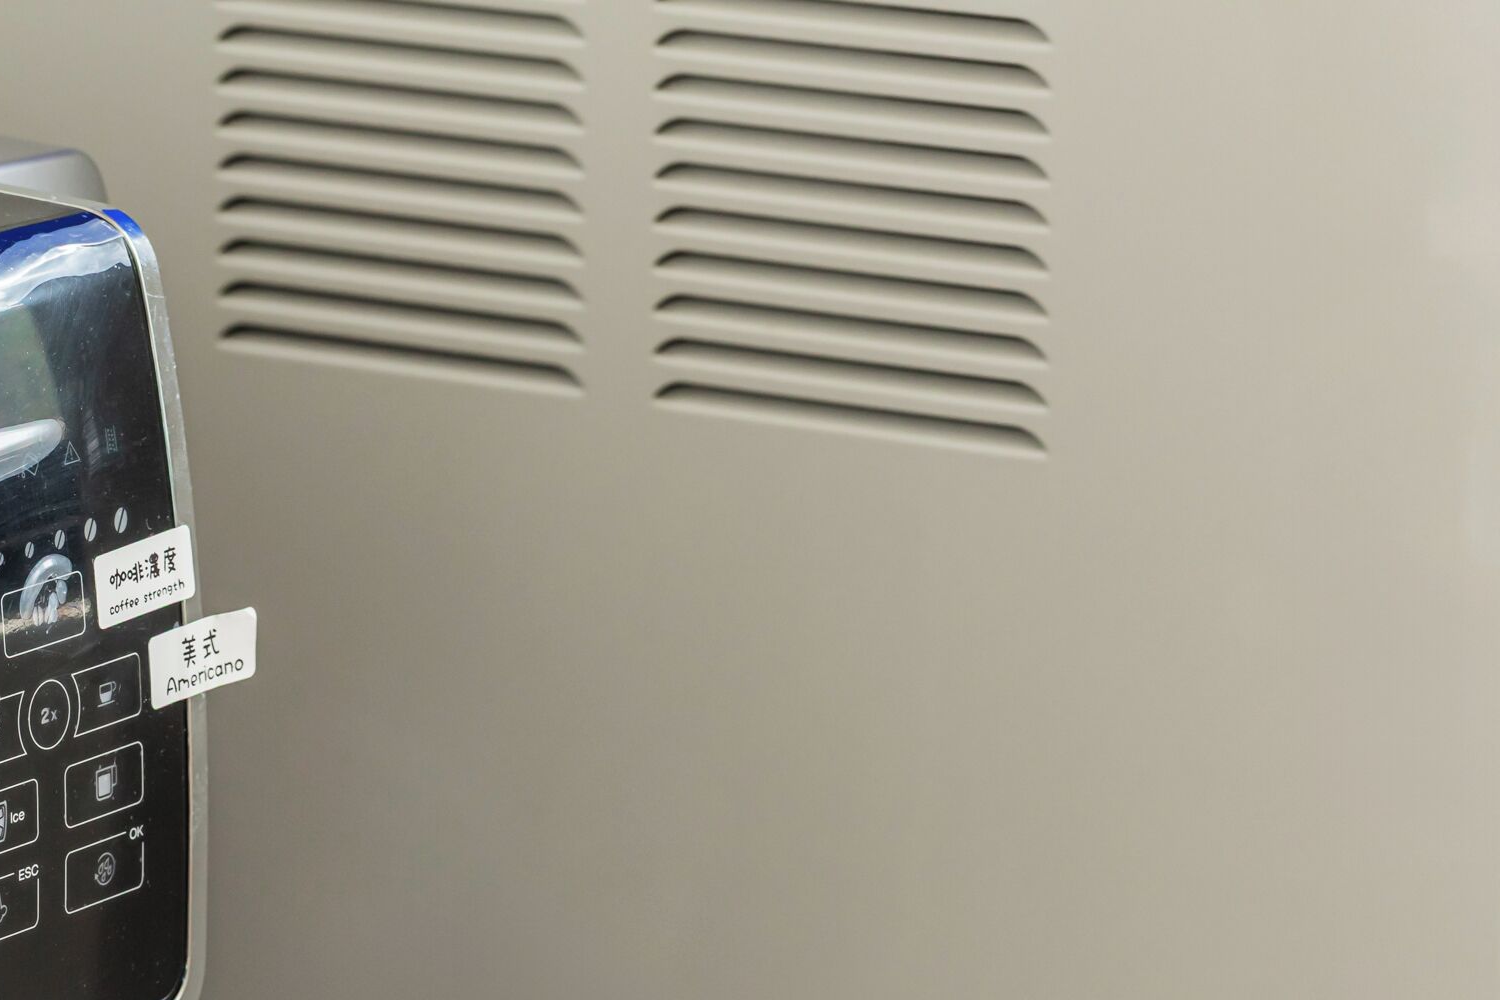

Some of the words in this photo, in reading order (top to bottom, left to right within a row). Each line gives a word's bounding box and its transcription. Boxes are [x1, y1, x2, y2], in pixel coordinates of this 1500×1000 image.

[109, 546, 177, 590] 咖啡濃度
[109, 597, 140, 616] coffee
[143, 579, 185, 604] strength
[181, 628, 220, 669] 美式
[166, 658, 244, 696] Americano
[10, 810, 26, 824] Ice
[128, 824, 145, 840] OK
[18, 864, 40, 882] ESC
